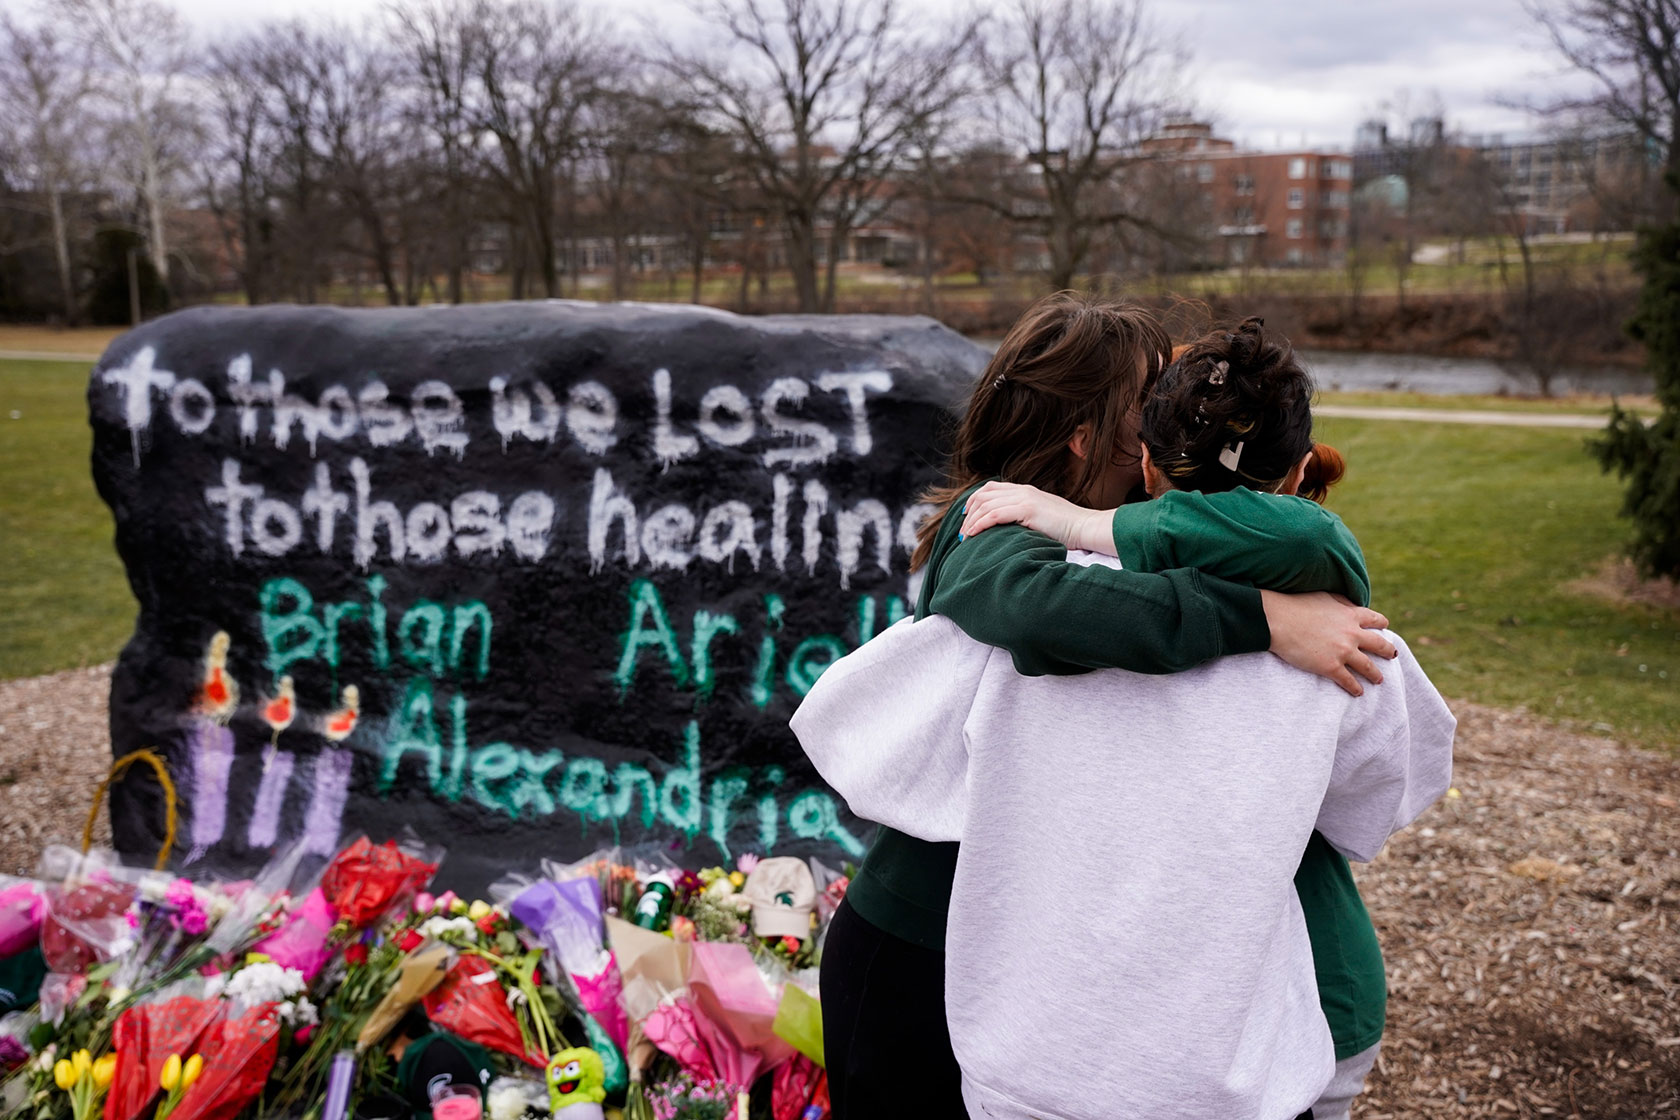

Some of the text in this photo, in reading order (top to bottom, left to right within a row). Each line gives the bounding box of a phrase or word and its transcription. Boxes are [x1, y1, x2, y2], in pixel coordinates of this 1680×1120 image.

[227, 352, 471, 462] those
[489, 376, 617, 456] we
[259, 576, 493, 690] Brian
[377, 675, 866, 862] Alexandria
